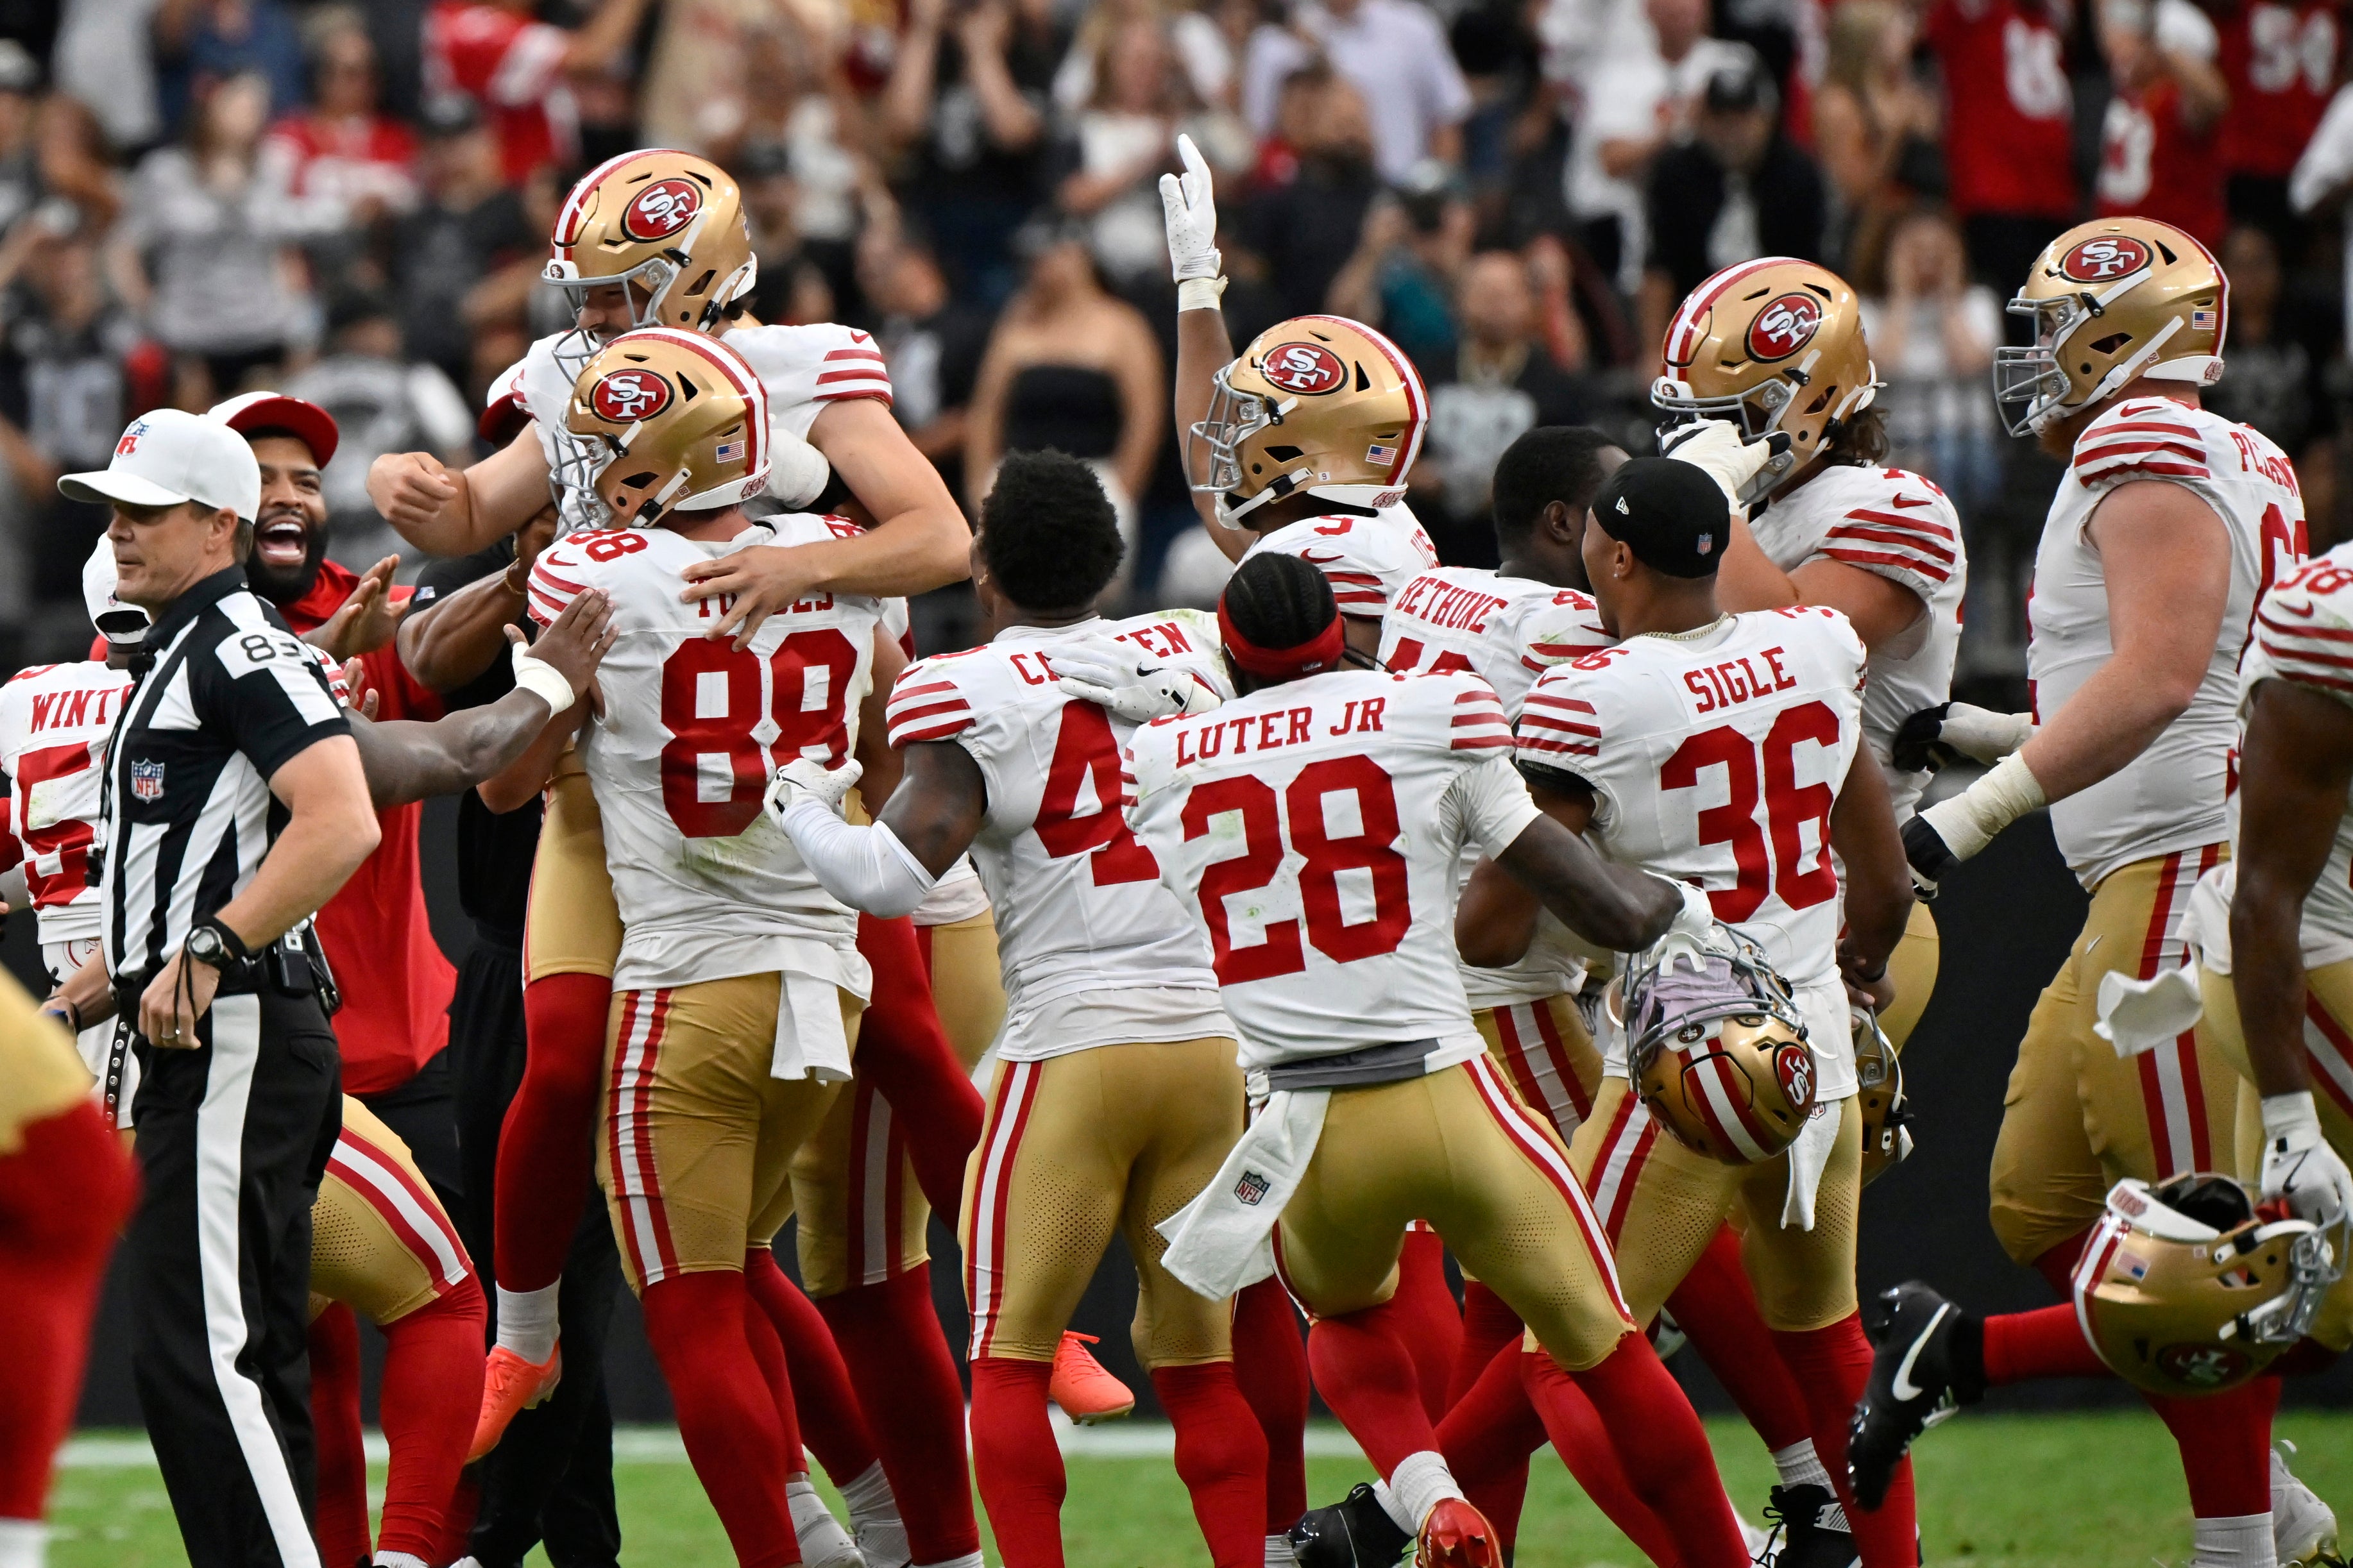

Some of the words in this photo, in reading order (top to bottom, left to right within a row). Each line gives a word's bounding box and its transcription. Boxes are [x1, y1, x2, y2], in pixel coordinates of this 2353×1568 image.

[638, 186, 691, 232] SF
[2082, 239, 2136, 278] SF
[1759, 304, 1815, 348] SF
[1280, 344, 1330, 389] SF
[607, 376, 657, 419] SF
[678, 487, 688, 496] 88
[1396, 576, 1508, 634] BETHUNE
[1683, 646, 1797, 714] SIGLE
[660, 628, 858, 838] 88
[1176, 705, 1312, 769] LUTER
[1330, 696, 1386, 737] JR
[136, 777, 160, 797] NFL
[1660, 700, 1840, 925] 36
[1180, 754, 1413, 987] 28
